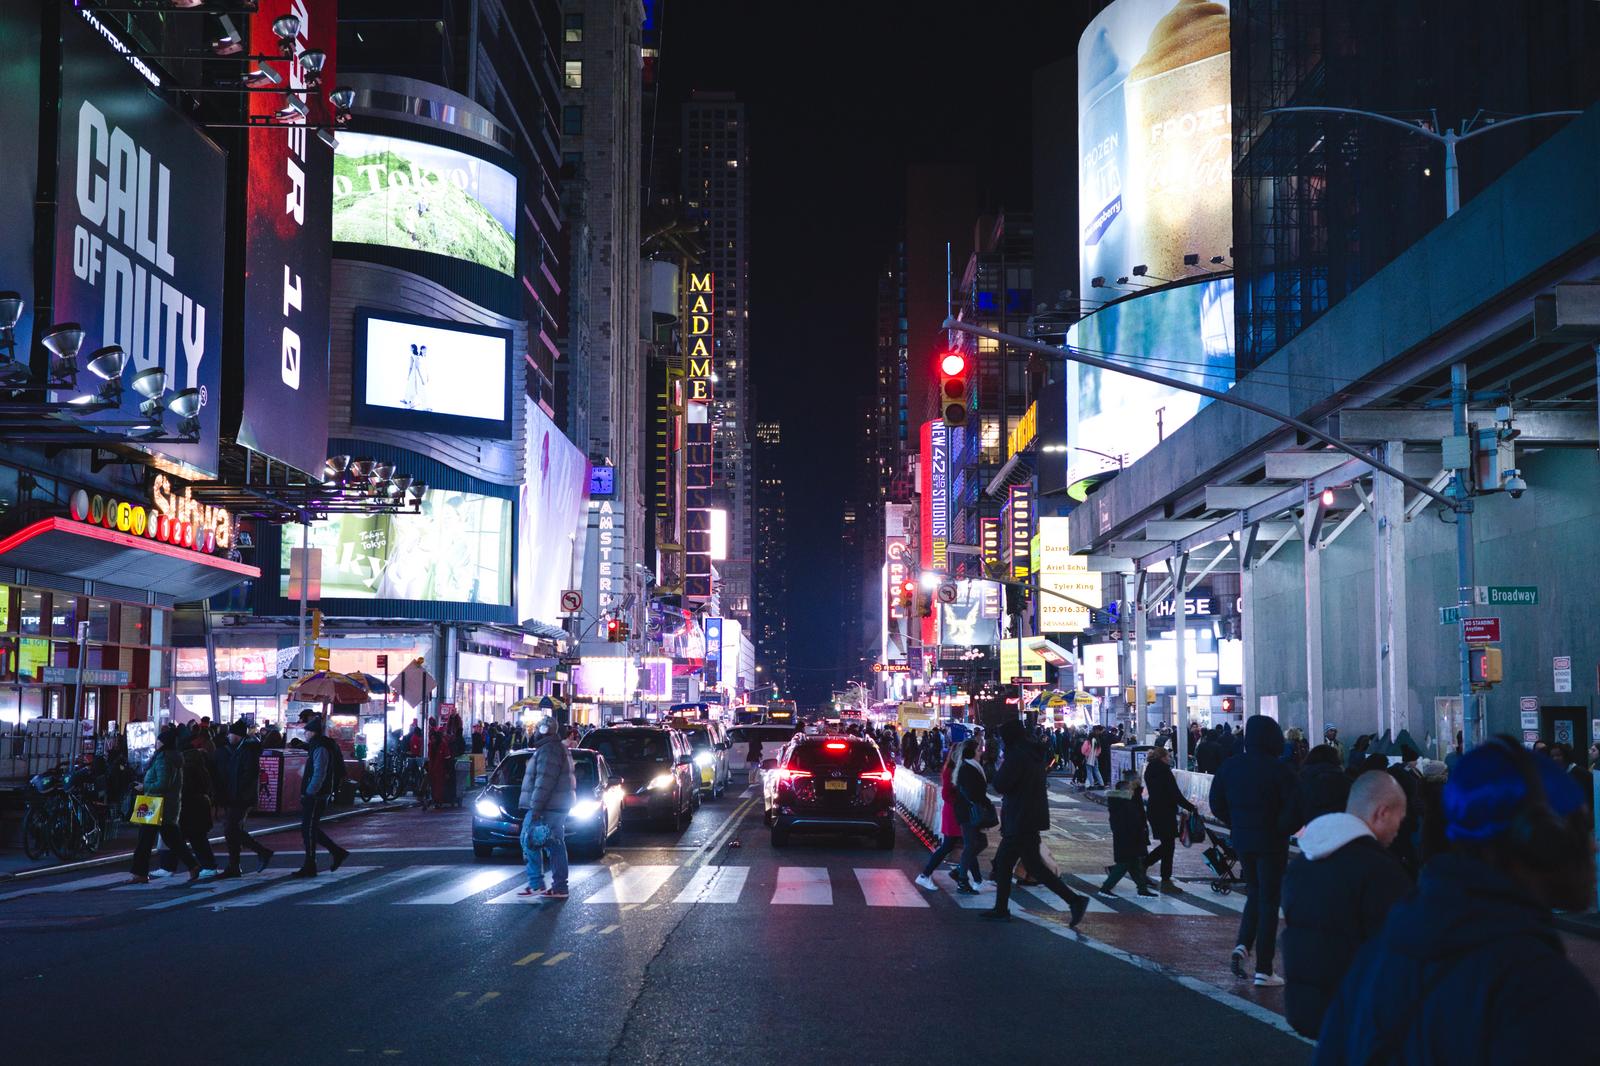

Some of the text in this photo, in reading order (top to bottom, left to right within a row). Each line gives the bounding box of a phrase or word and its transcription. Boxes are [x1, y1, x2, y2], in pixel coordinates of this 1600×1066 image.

[1083, 132, 1119, 171] FROZEN
[76, 100, 175, 277] CALL
[73, 224, 206, 392] OF DUTY
[689, 272, 712, 400] MADAME
[932, 421, 946, 446] NEW
[932, 447, 946, 474] 42
[932, 489, 946, 536] STUDIOS
[1014, 490, 1028, 557] VICTORY
[361, 540, 387, 550] Tokyo
[932, 541, 947, 569] DUKE
[598, 501, 613, 637] AMSTERDA
[890, 563, 904, 618] REGAL
[1076, 583, 1094, 591] King
[1491, 589, 1536, 604] Broadway
